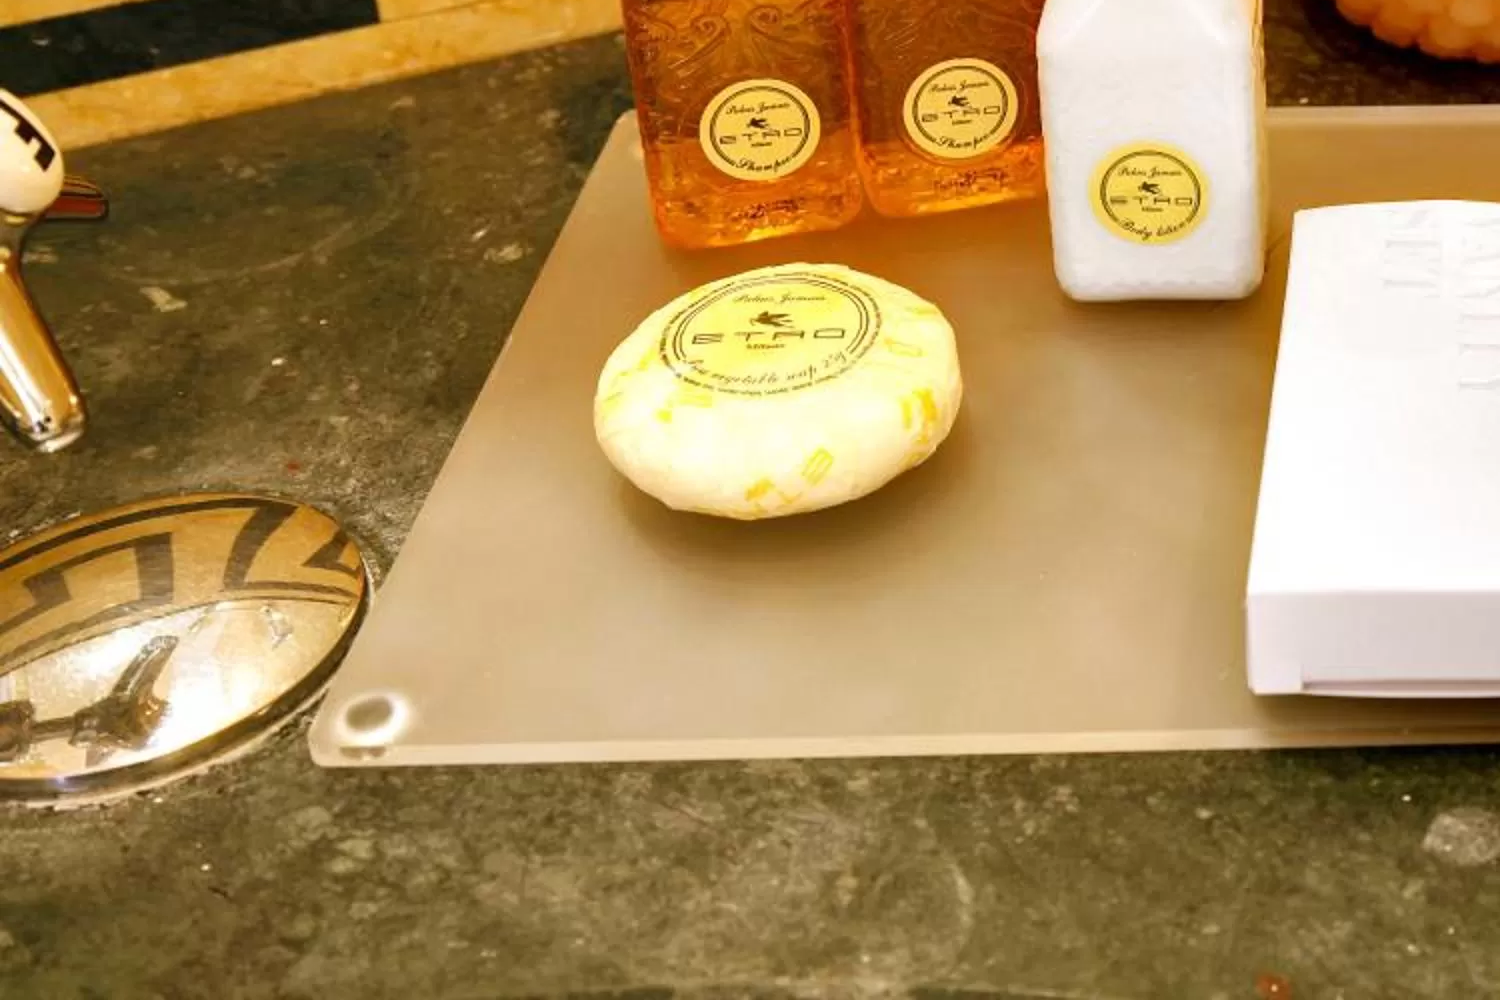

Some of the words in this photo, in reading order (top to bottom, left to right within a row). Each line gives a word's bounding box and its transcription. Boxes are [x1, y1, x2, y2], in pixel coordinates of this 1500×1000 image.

[1120, 218, 1153, 241] Body
[1381, 209, 1442, 298] SET
[691, 327, 846, 345] ETRO
